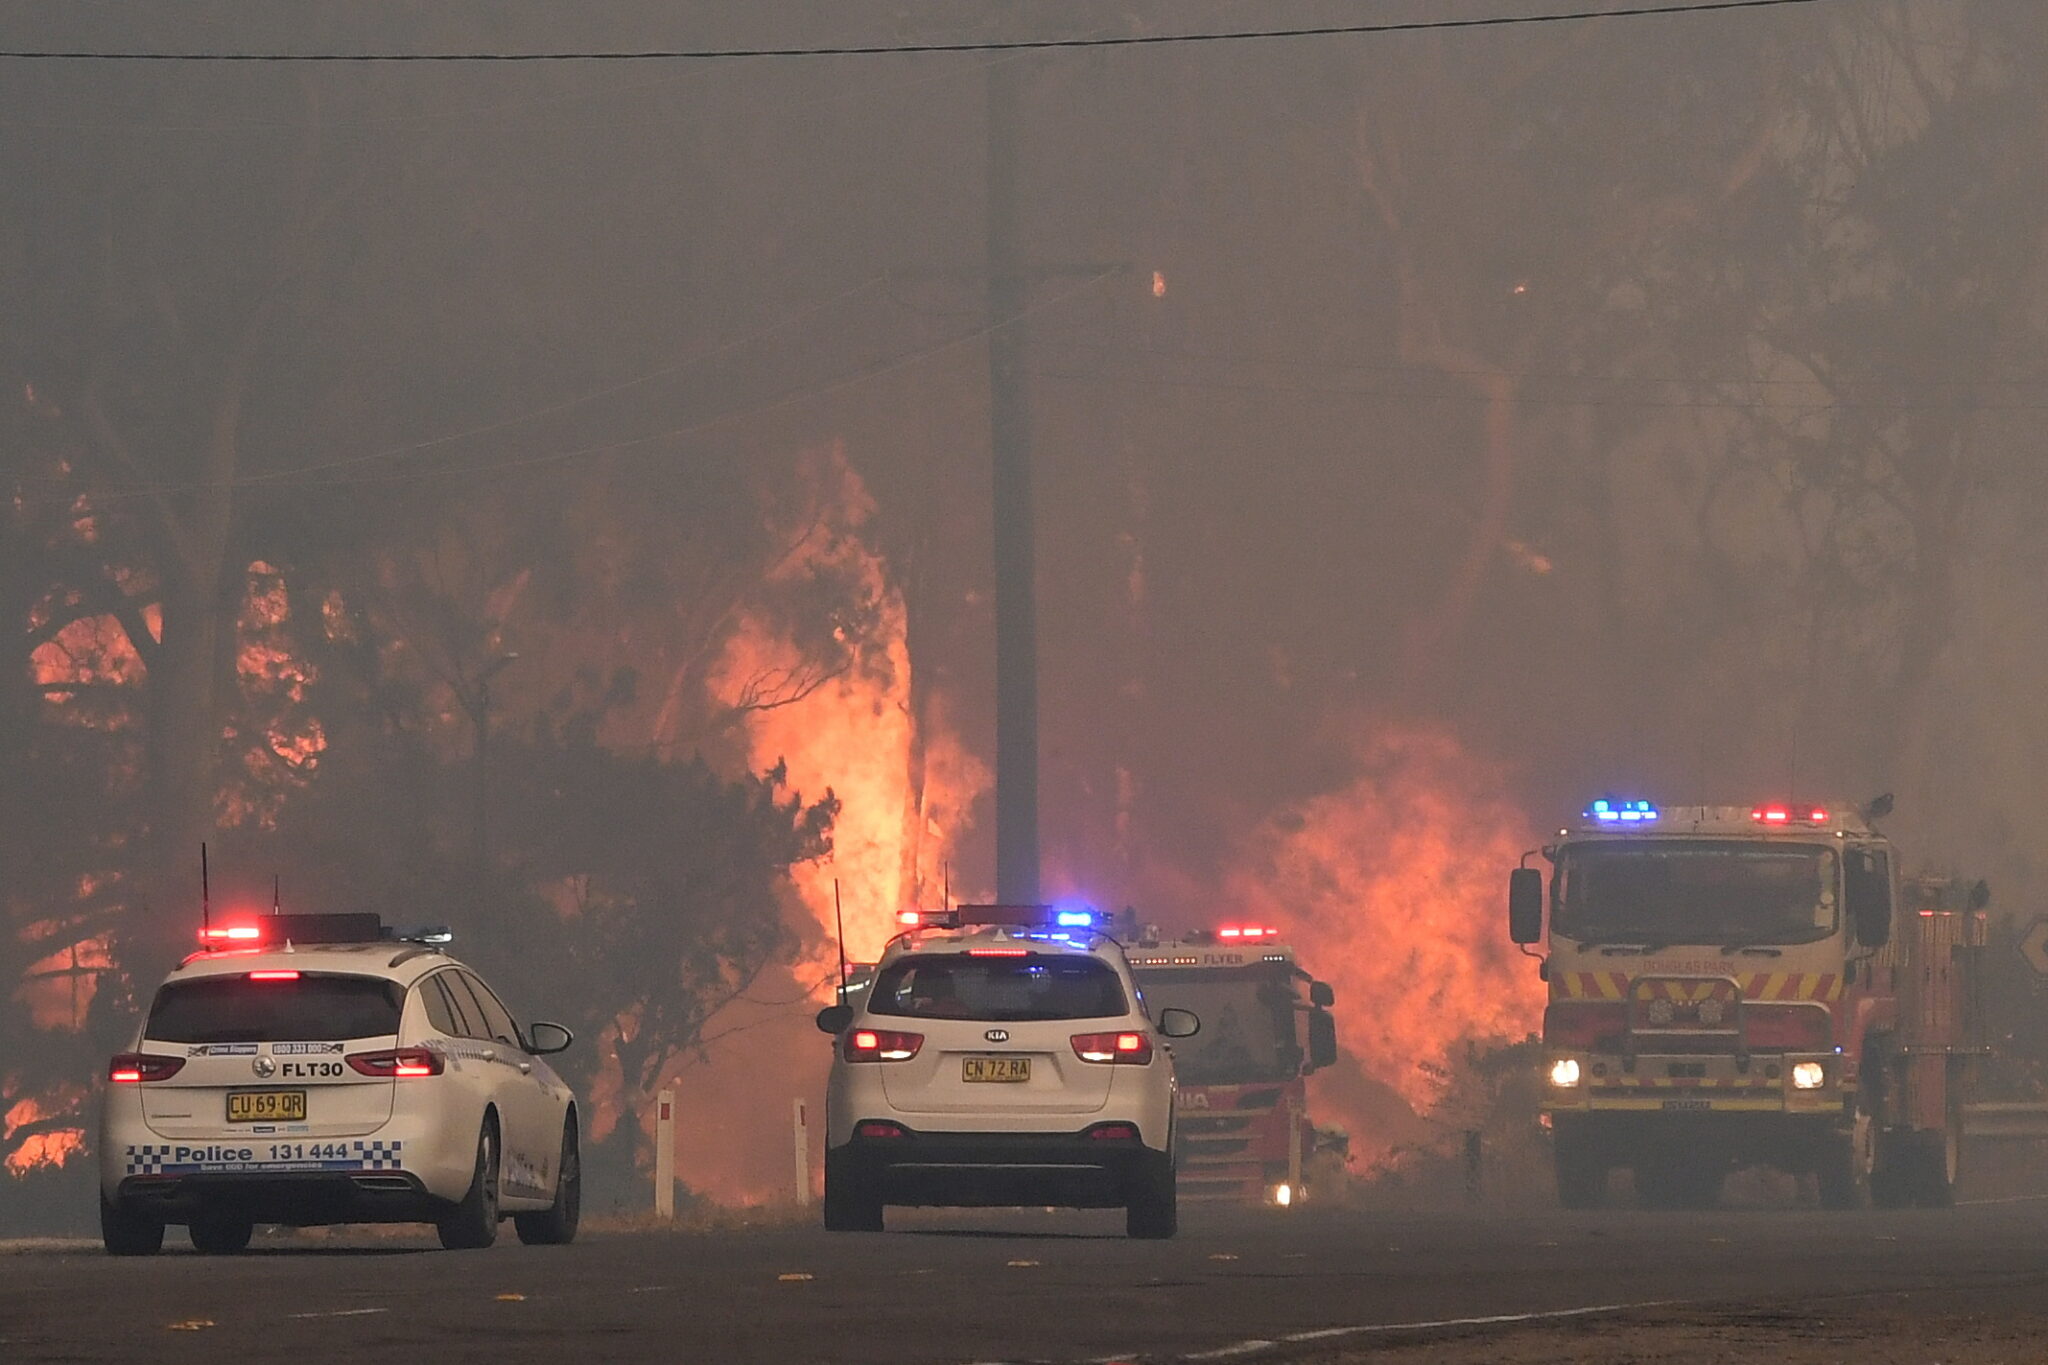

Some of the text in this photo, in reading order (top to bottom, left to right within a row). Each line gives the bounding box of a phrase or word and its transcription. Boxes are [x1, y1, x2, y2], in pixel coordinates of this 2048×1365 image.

[1204, 953, 1243, 965] FLYER
[987, 1031, 1007, 1040] KIA
[282, 1062, 344, 1077] FLT30
[966, 1061, 1027, 1076] CN 72 RA
[175, 1143, 348, 1162] Police 131 444
